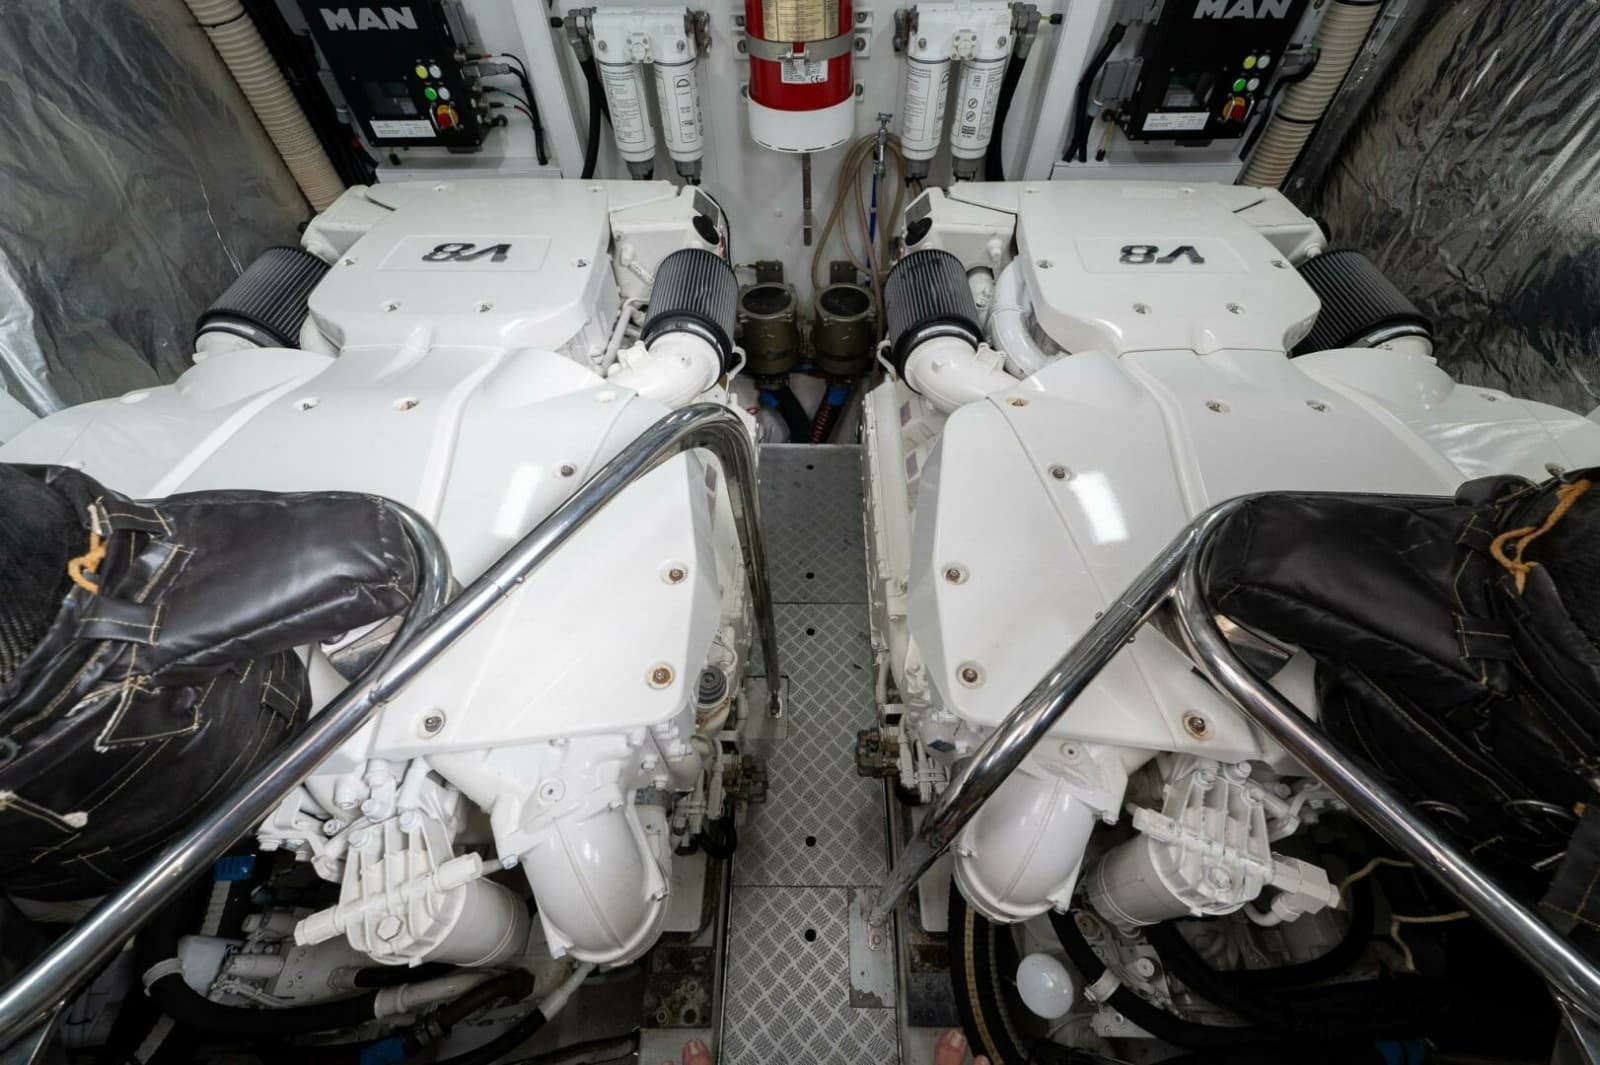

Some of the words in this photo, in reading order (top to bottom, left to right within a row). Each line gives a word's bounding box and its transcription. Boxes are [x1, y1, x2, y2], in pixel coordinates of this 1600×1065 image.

[320, 7, 418, 30] MAN
[1193, 0, 1292, 19] MAN
[422, 242, 512, 262] V8
[1119, 245, 1205, 264] V8
